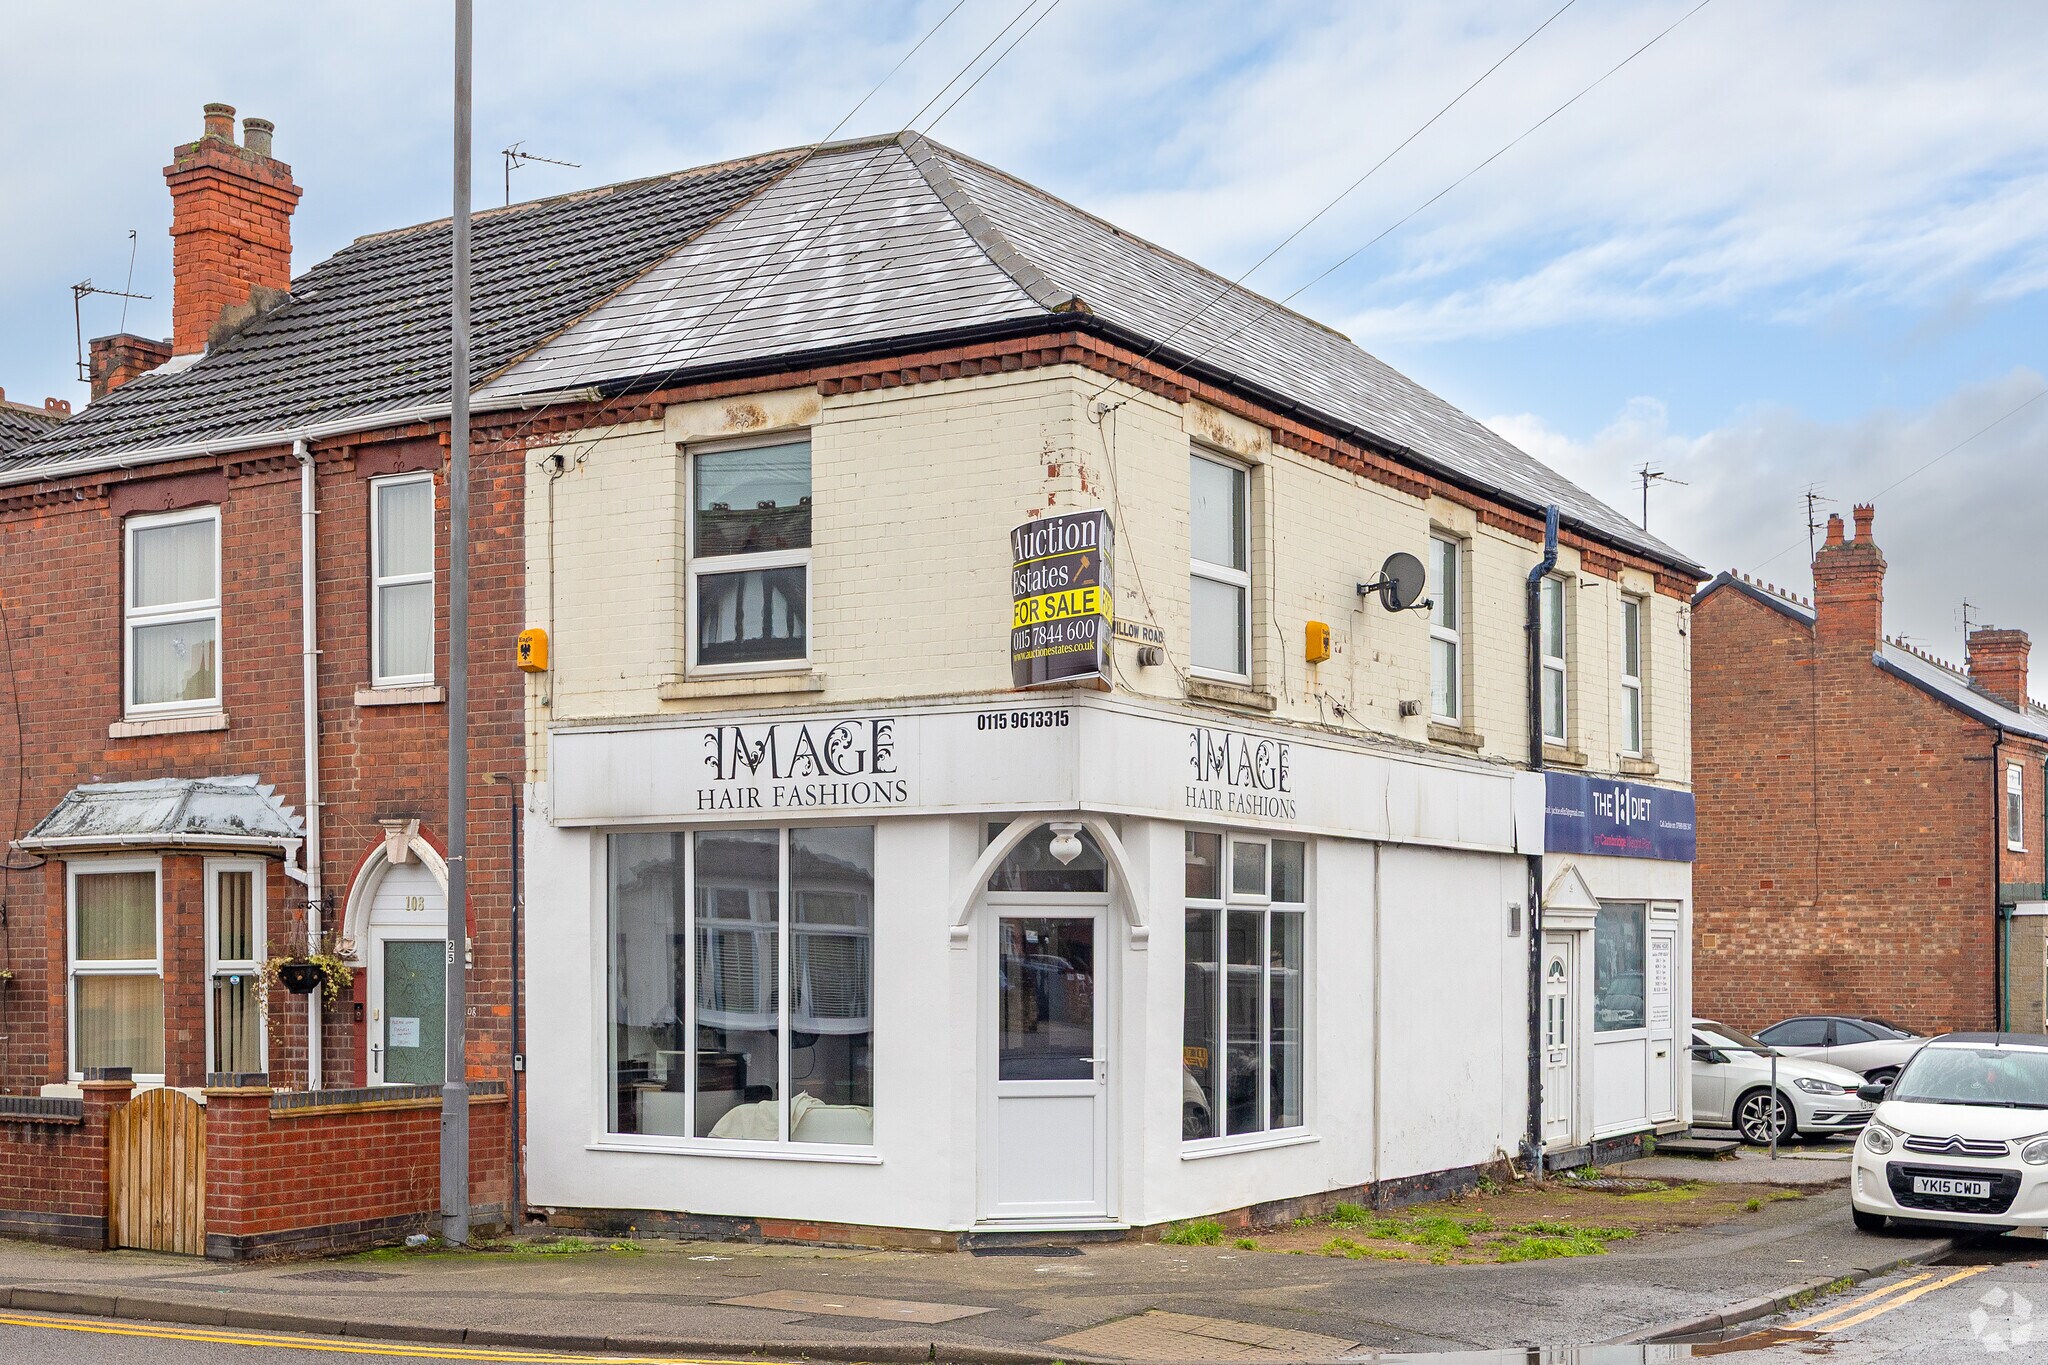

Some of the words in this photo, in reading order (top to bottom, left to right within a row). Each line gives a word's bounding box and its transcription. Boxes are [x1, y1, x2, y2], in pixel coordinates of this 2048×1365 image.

[1013, 518, 1097, 563] Auction
[1013, 565, 1069, 597] Estates
[1013, 597, 1040, 626] FOR
[1045, 590, 1095, 618] SALE
[1013, 628, 1031, 651] 0115
[1033, 623, 1064, 647] 7844
[1067, 619, 1096, 640] 600
[1013, 639, 1096, 662] www.auctionestates.co.uk
[1142, 627, 1164, 643] ROAD
[977, 713, 1008, 731] 0115
[1010, 710, 1069, 729] 9613315
[703, 718, 898, 781] IMAGE
[1189, 727, 1291, 793] IMAGE
[696, 785, 763, 810] HAIR
[772, 779, 908, 808] FASHIONS
[1185, 786, 1223, 812] HAIR
[1228, 791, 1297, 820] FASHIONS
[1592, 791, 1613, 817] THE
[1614, 786, 1630, 826] 1:1
[1631, 796, 1652, 822] DIET
[405, 896, 425, 911] 108
[465, 1006, 477, 1017] 08
[1921, 1179, 1951, 1193] YK15
[1954, 1182, 1981, 1195] CWD
